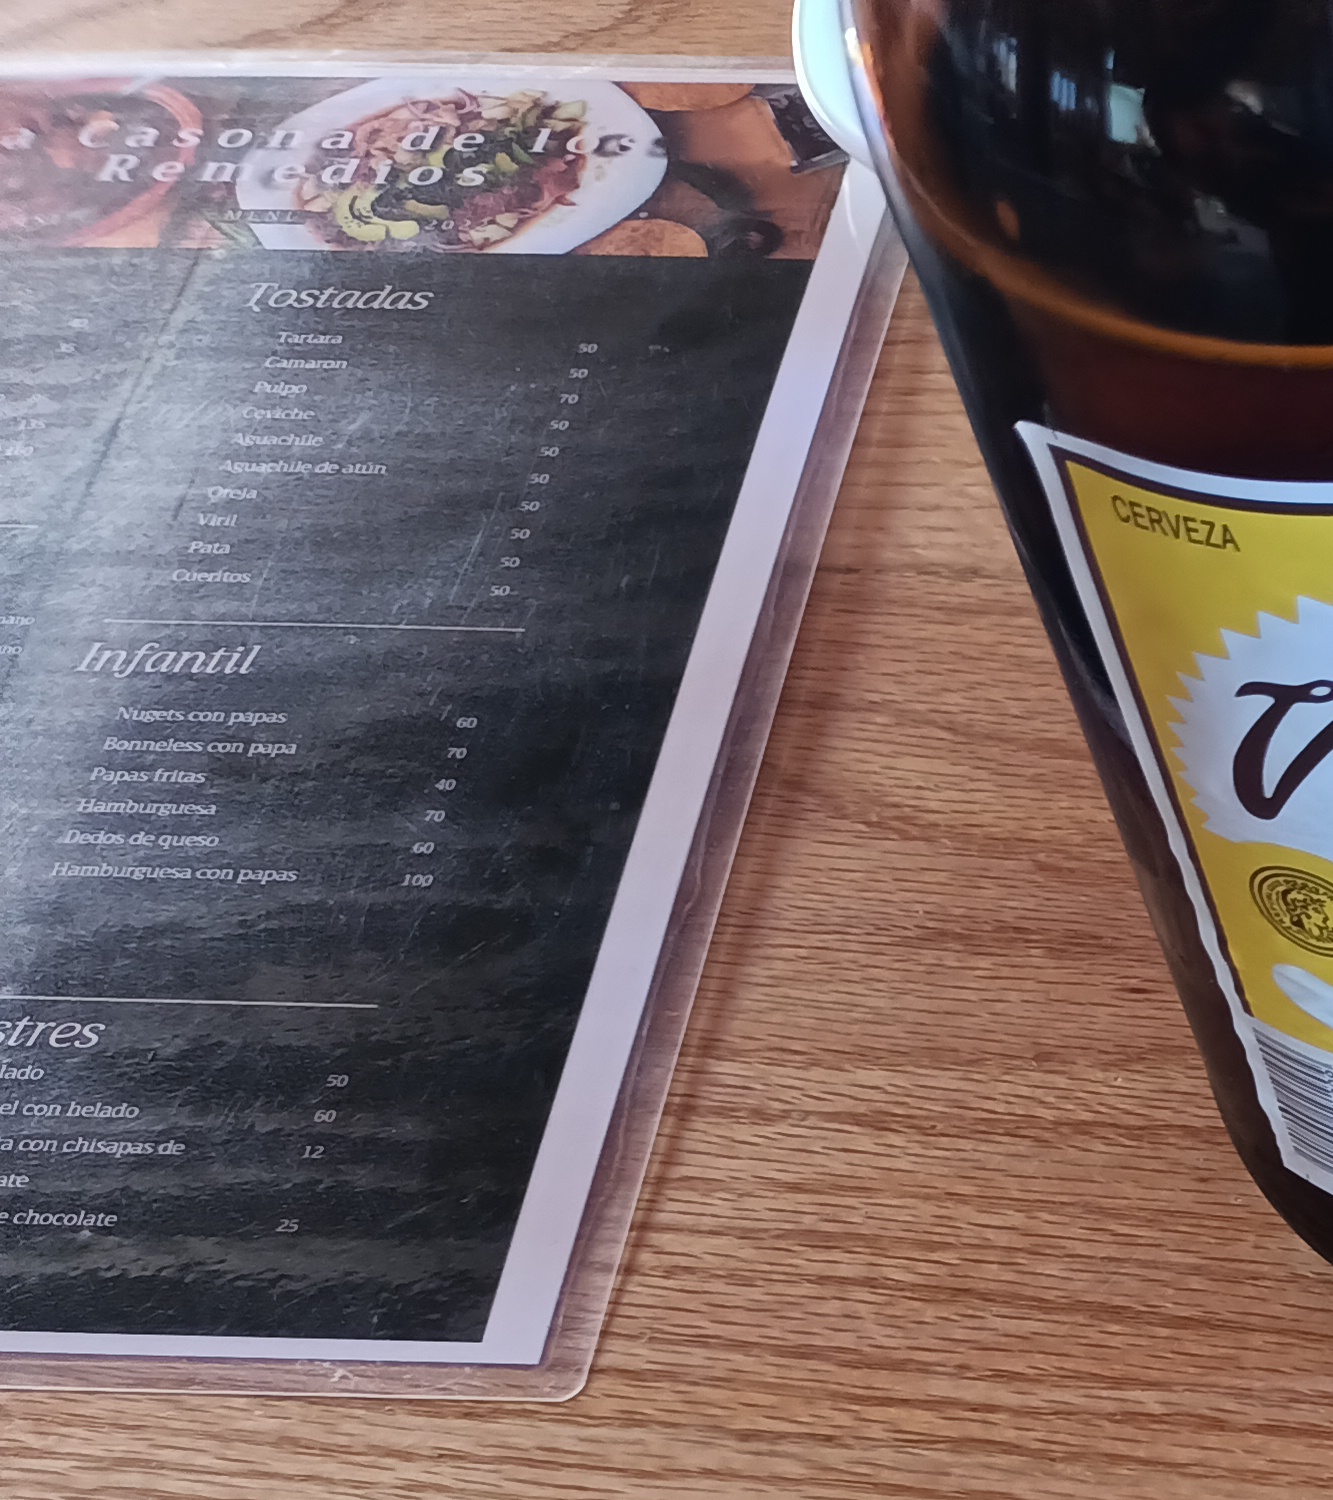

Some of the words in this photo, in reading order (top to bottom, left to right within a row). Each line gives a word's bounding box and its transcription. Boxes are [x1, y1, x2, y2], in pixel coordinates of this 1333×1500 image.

[78, 119, 355, 150] Casona
[401, 126, 485, 152] de
[96, 153, 487, 187] Remedios
[246, 282, 434, 312] Tostadas
[277, 331, 343, 344] Tartara
[578, 343, 598, 354] 50
[264, 356, 348, 369] Camaron
[568, 368, 589, 379] 50
[252, 381, 308, 397] Pulpo
[560, 393, 579, 405] 70
[242, 406, 316, 420] Ceviche
[549, 420, 570, 431] 50
[231, 432, 324, 447] Aguachile
[540, 446, 559, 457] 50
[218, 459, 312, 473] Aguachile
[314, 461, 340, 473] de
[341, 461, 388, 475] atún
[529, 473, 550, 484] 50
[206, 485, 258, 500] Oreja
[519, 501, 541, 512] 50
[198, 513, 238, 527] Viril
[1111, 494, 1241, 552] CERVEZA
[510, 528, 531, 539] 50
[187, 540, 231, 554] Pata
[500, 556, 520, 568] 50
[171, 568, 252, 583] Cueritos
[489, 585, 510, 596] 50
[74, 642, 262, 678] Infantil
[114, 706, 185, 723] Nugets
[187, 711, 224, 722] con
[227, 711, 288, 726] papas
[456, 717, 478, 729] 60
[103, 736, 204, 753] Bonneless
[207, 741, 243, 753] con
[247, 742, 297, 757] papa
[447, 747, 468, 759] 70
[89, 767, 149, 784] Papas
[153, 768, 208, 783] fritas
[434, 779, 457, 791] 40
[76, 798, 217, 816] Hamburguesa
[424, 809, 446, 822] 70
[62, 829, 125, 845] Dedos
[128, 831, 155, 845] de
[158, 834, 220, 849] queso
[412, 841, 435, 854] 60
[50, 861, 192, 880] Hamburguesa
[195, 868, 233, 881] con
[236, 869, 299, 885] papas
[401, 874, 434, 887] 100
[326, 1074, 349, 1087] 50
[22, 1104, 62, 1117] con
[66, 1101, 140, 1118] helado
[313, 1109, 337, 1123] 60
[19, 1138, 57, 1151] con
[62, 1136, 155, 1158] chisapas
[157, 1139, 186, 1155] de
[301, 1145, 325, 1159] 12
[13, 1208, 118, 1226] chocolate
[275, 1218, 300, 1233] 25
